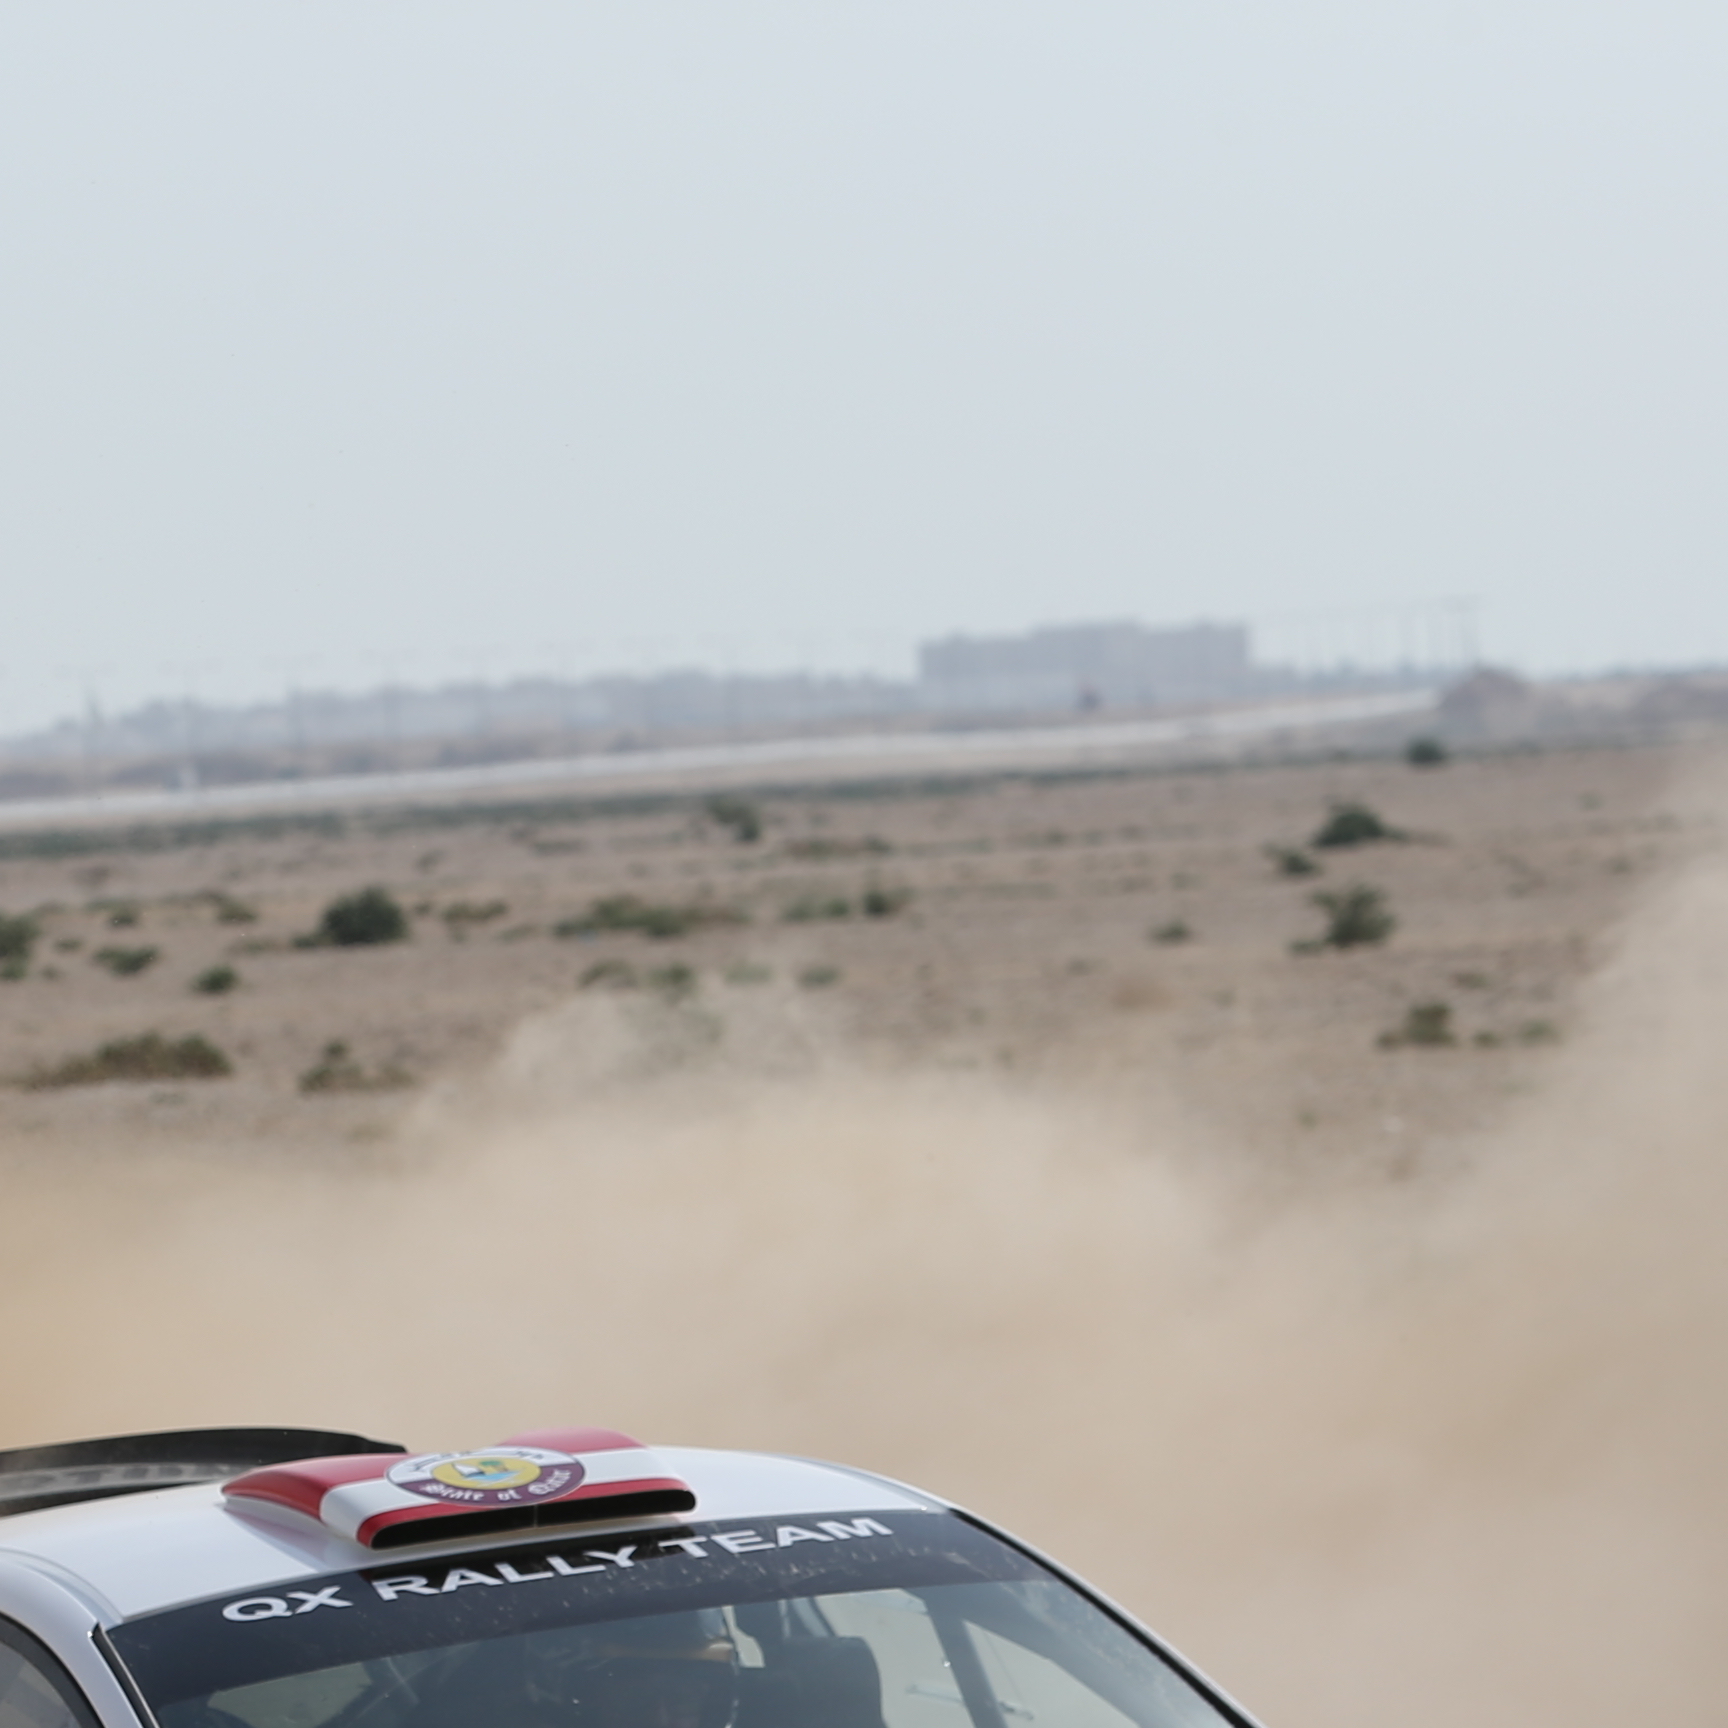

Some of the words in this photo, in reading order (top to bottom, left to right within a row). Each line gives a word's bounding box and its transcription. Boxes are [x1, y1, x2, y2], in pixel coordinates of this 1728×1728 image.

[222, 1585, 353, 1624] QX
[371, 1545, 642, 1602] RALLY
[658, 1516, 895, 1559] TEAM
